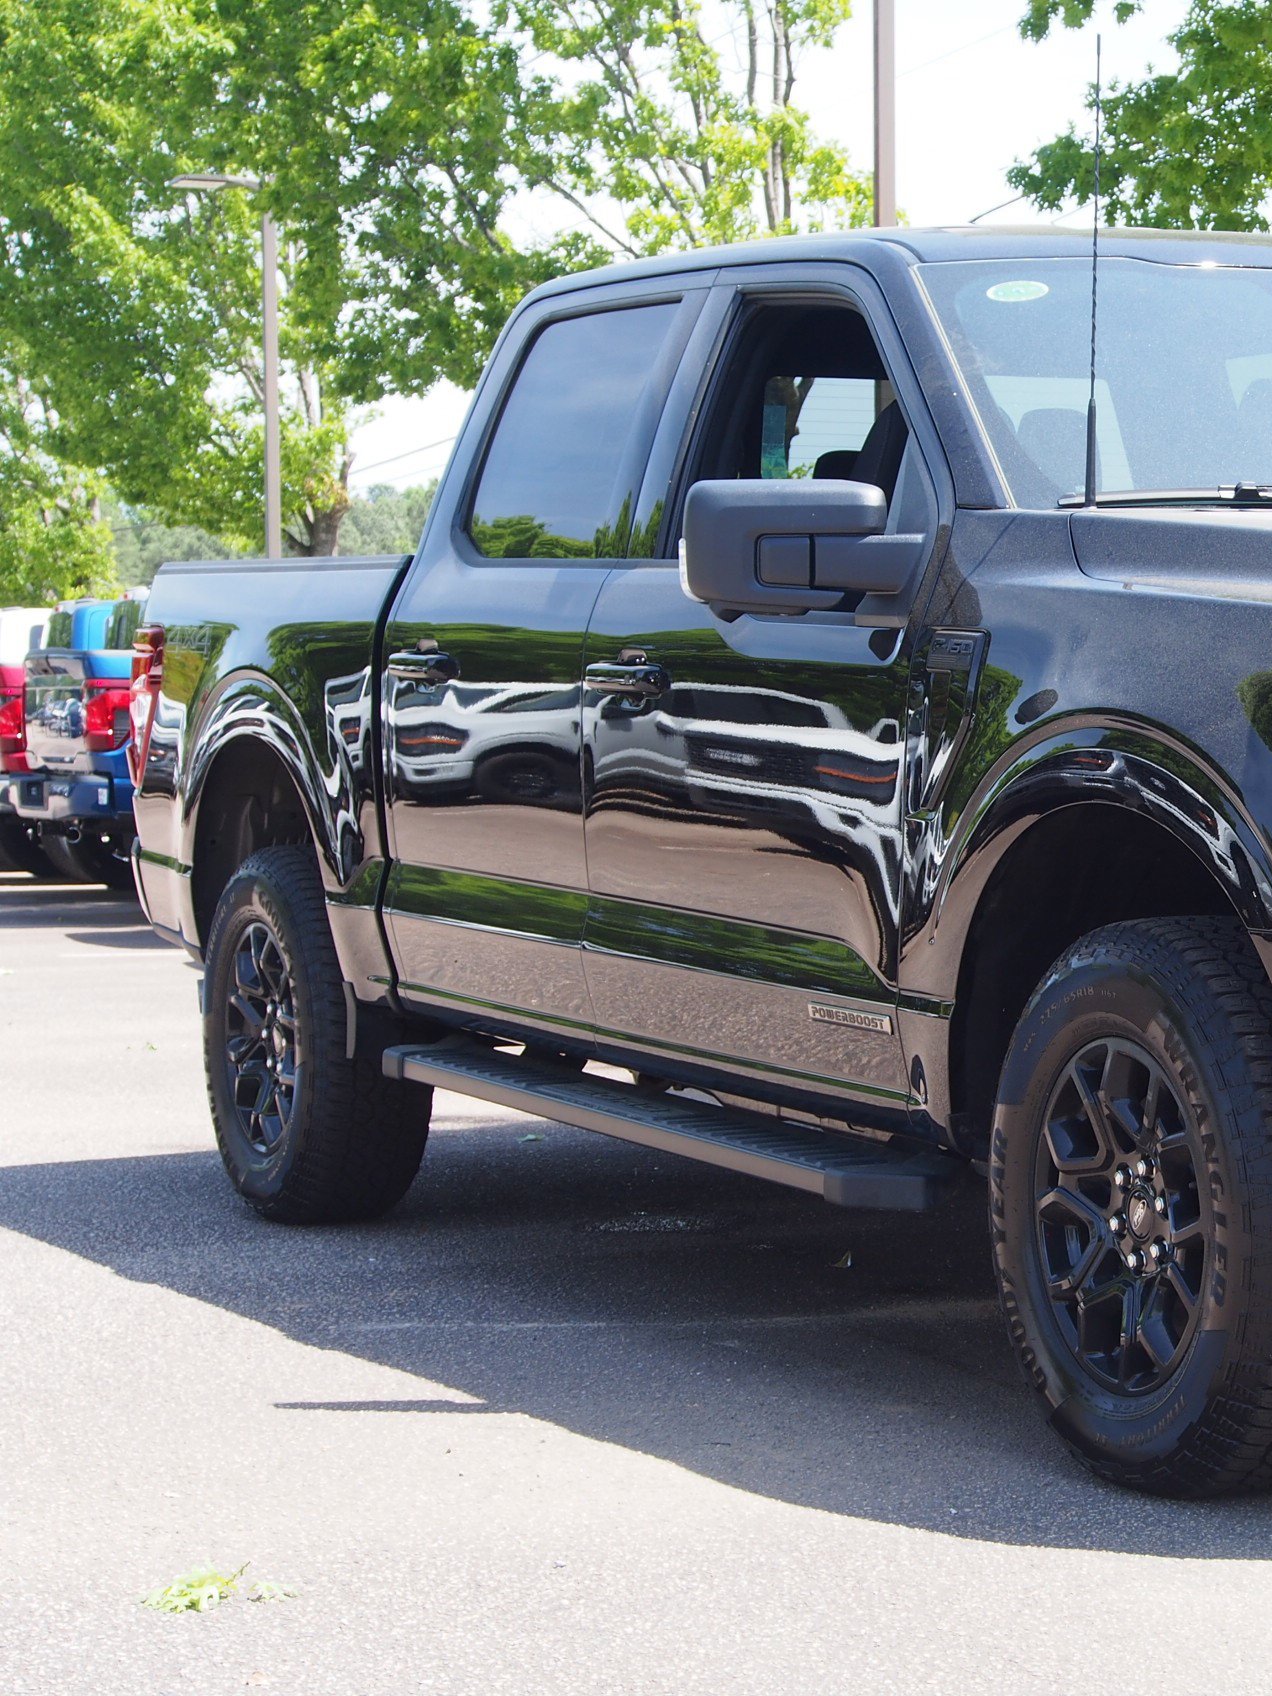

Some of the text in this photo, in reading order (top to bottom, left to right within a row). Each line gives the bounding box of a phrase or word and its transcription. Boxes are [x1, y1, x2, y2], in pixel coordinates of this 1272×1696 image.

[811, 1006, 885, 1030] POWERBOOST
[1040, 986, 1095, 1025] 275/65R18
[1163, 1024, 1229, 1308] WRANGLER
